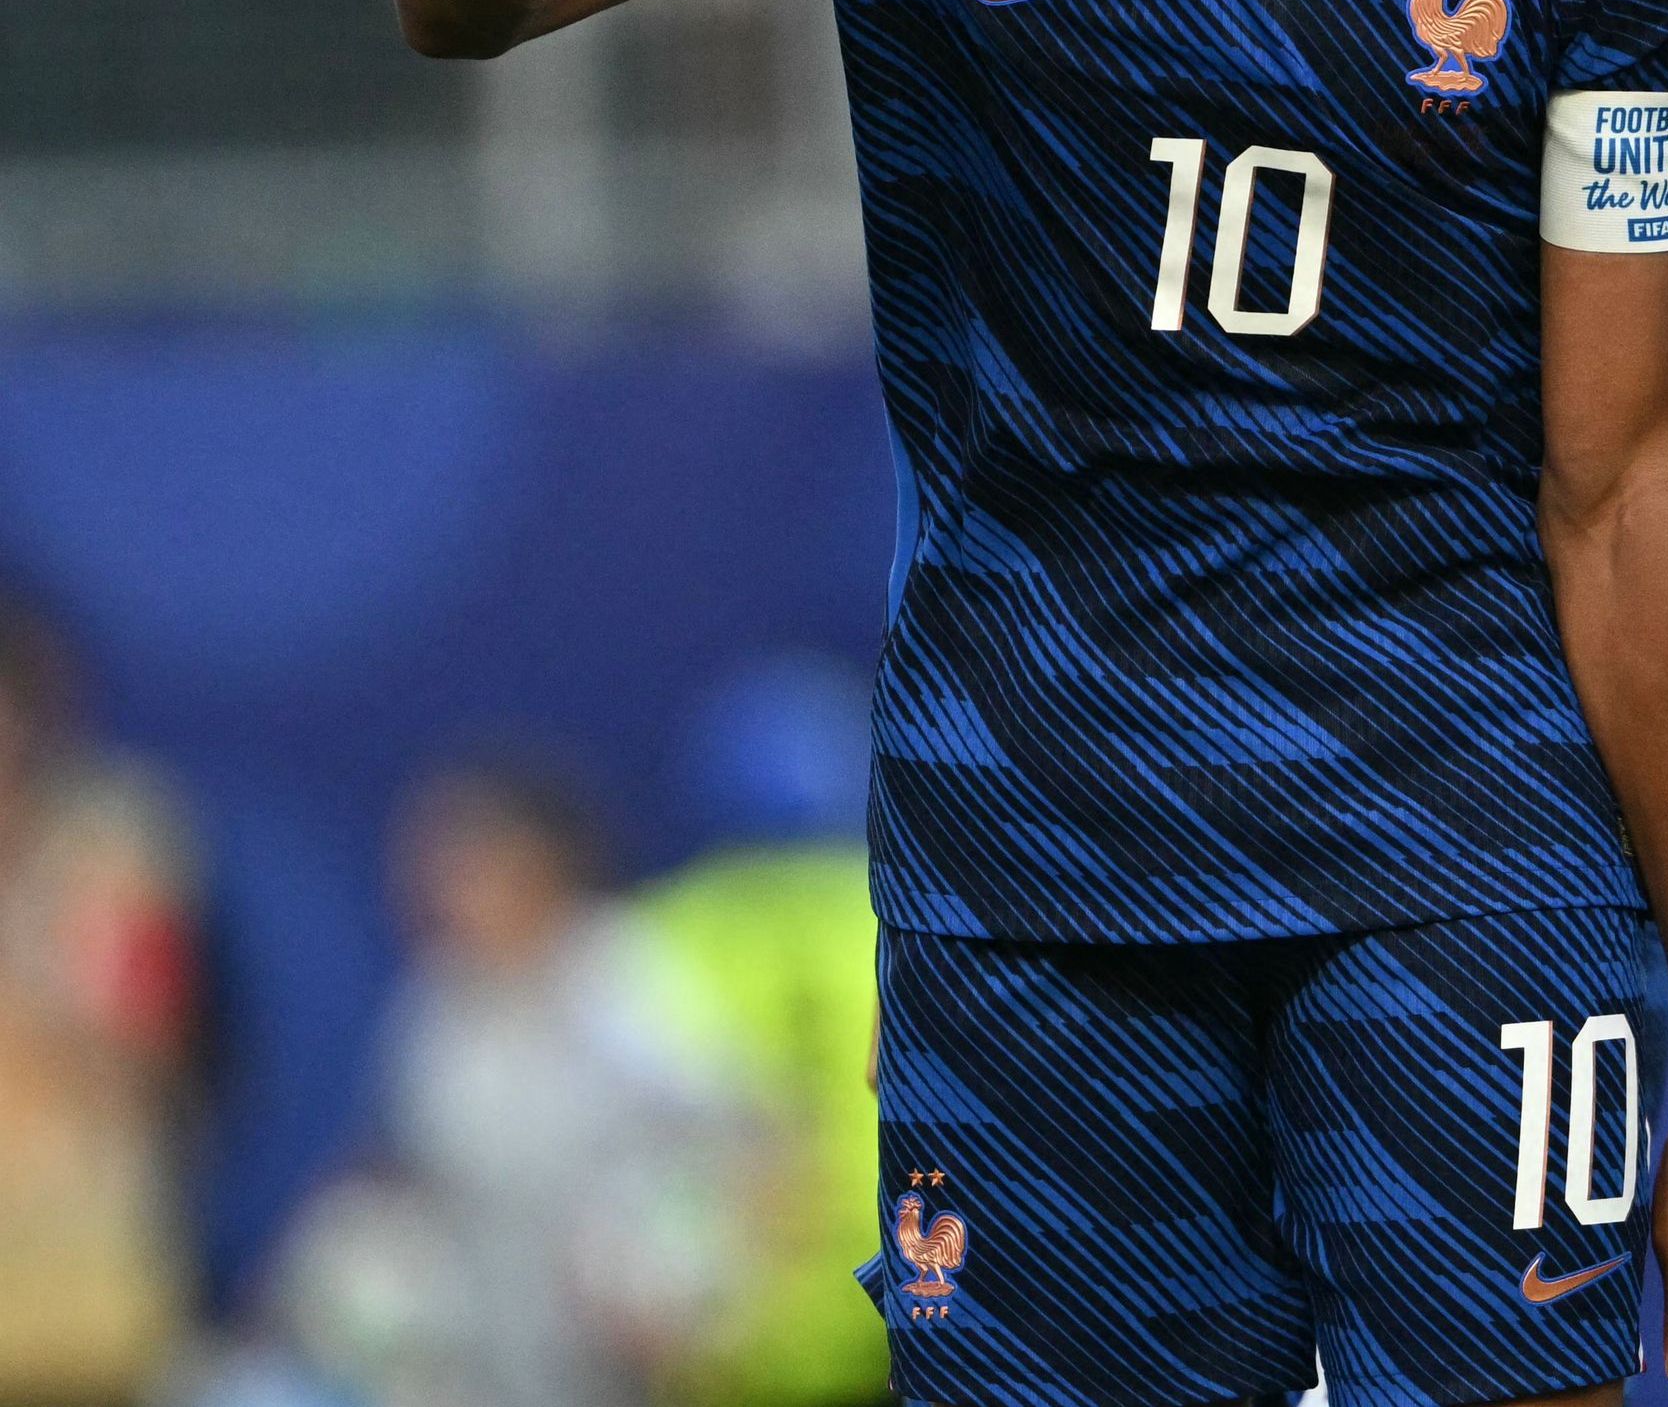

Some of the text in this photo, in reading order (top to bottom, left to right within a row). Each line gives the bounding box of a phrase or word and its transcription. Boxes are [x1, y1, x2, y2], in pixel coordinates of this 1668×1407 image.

[1149, 136, 1337, 337] 10
[1582, 178, 1635, 211] the
[1500, 1013, 1639, 1231] 10
